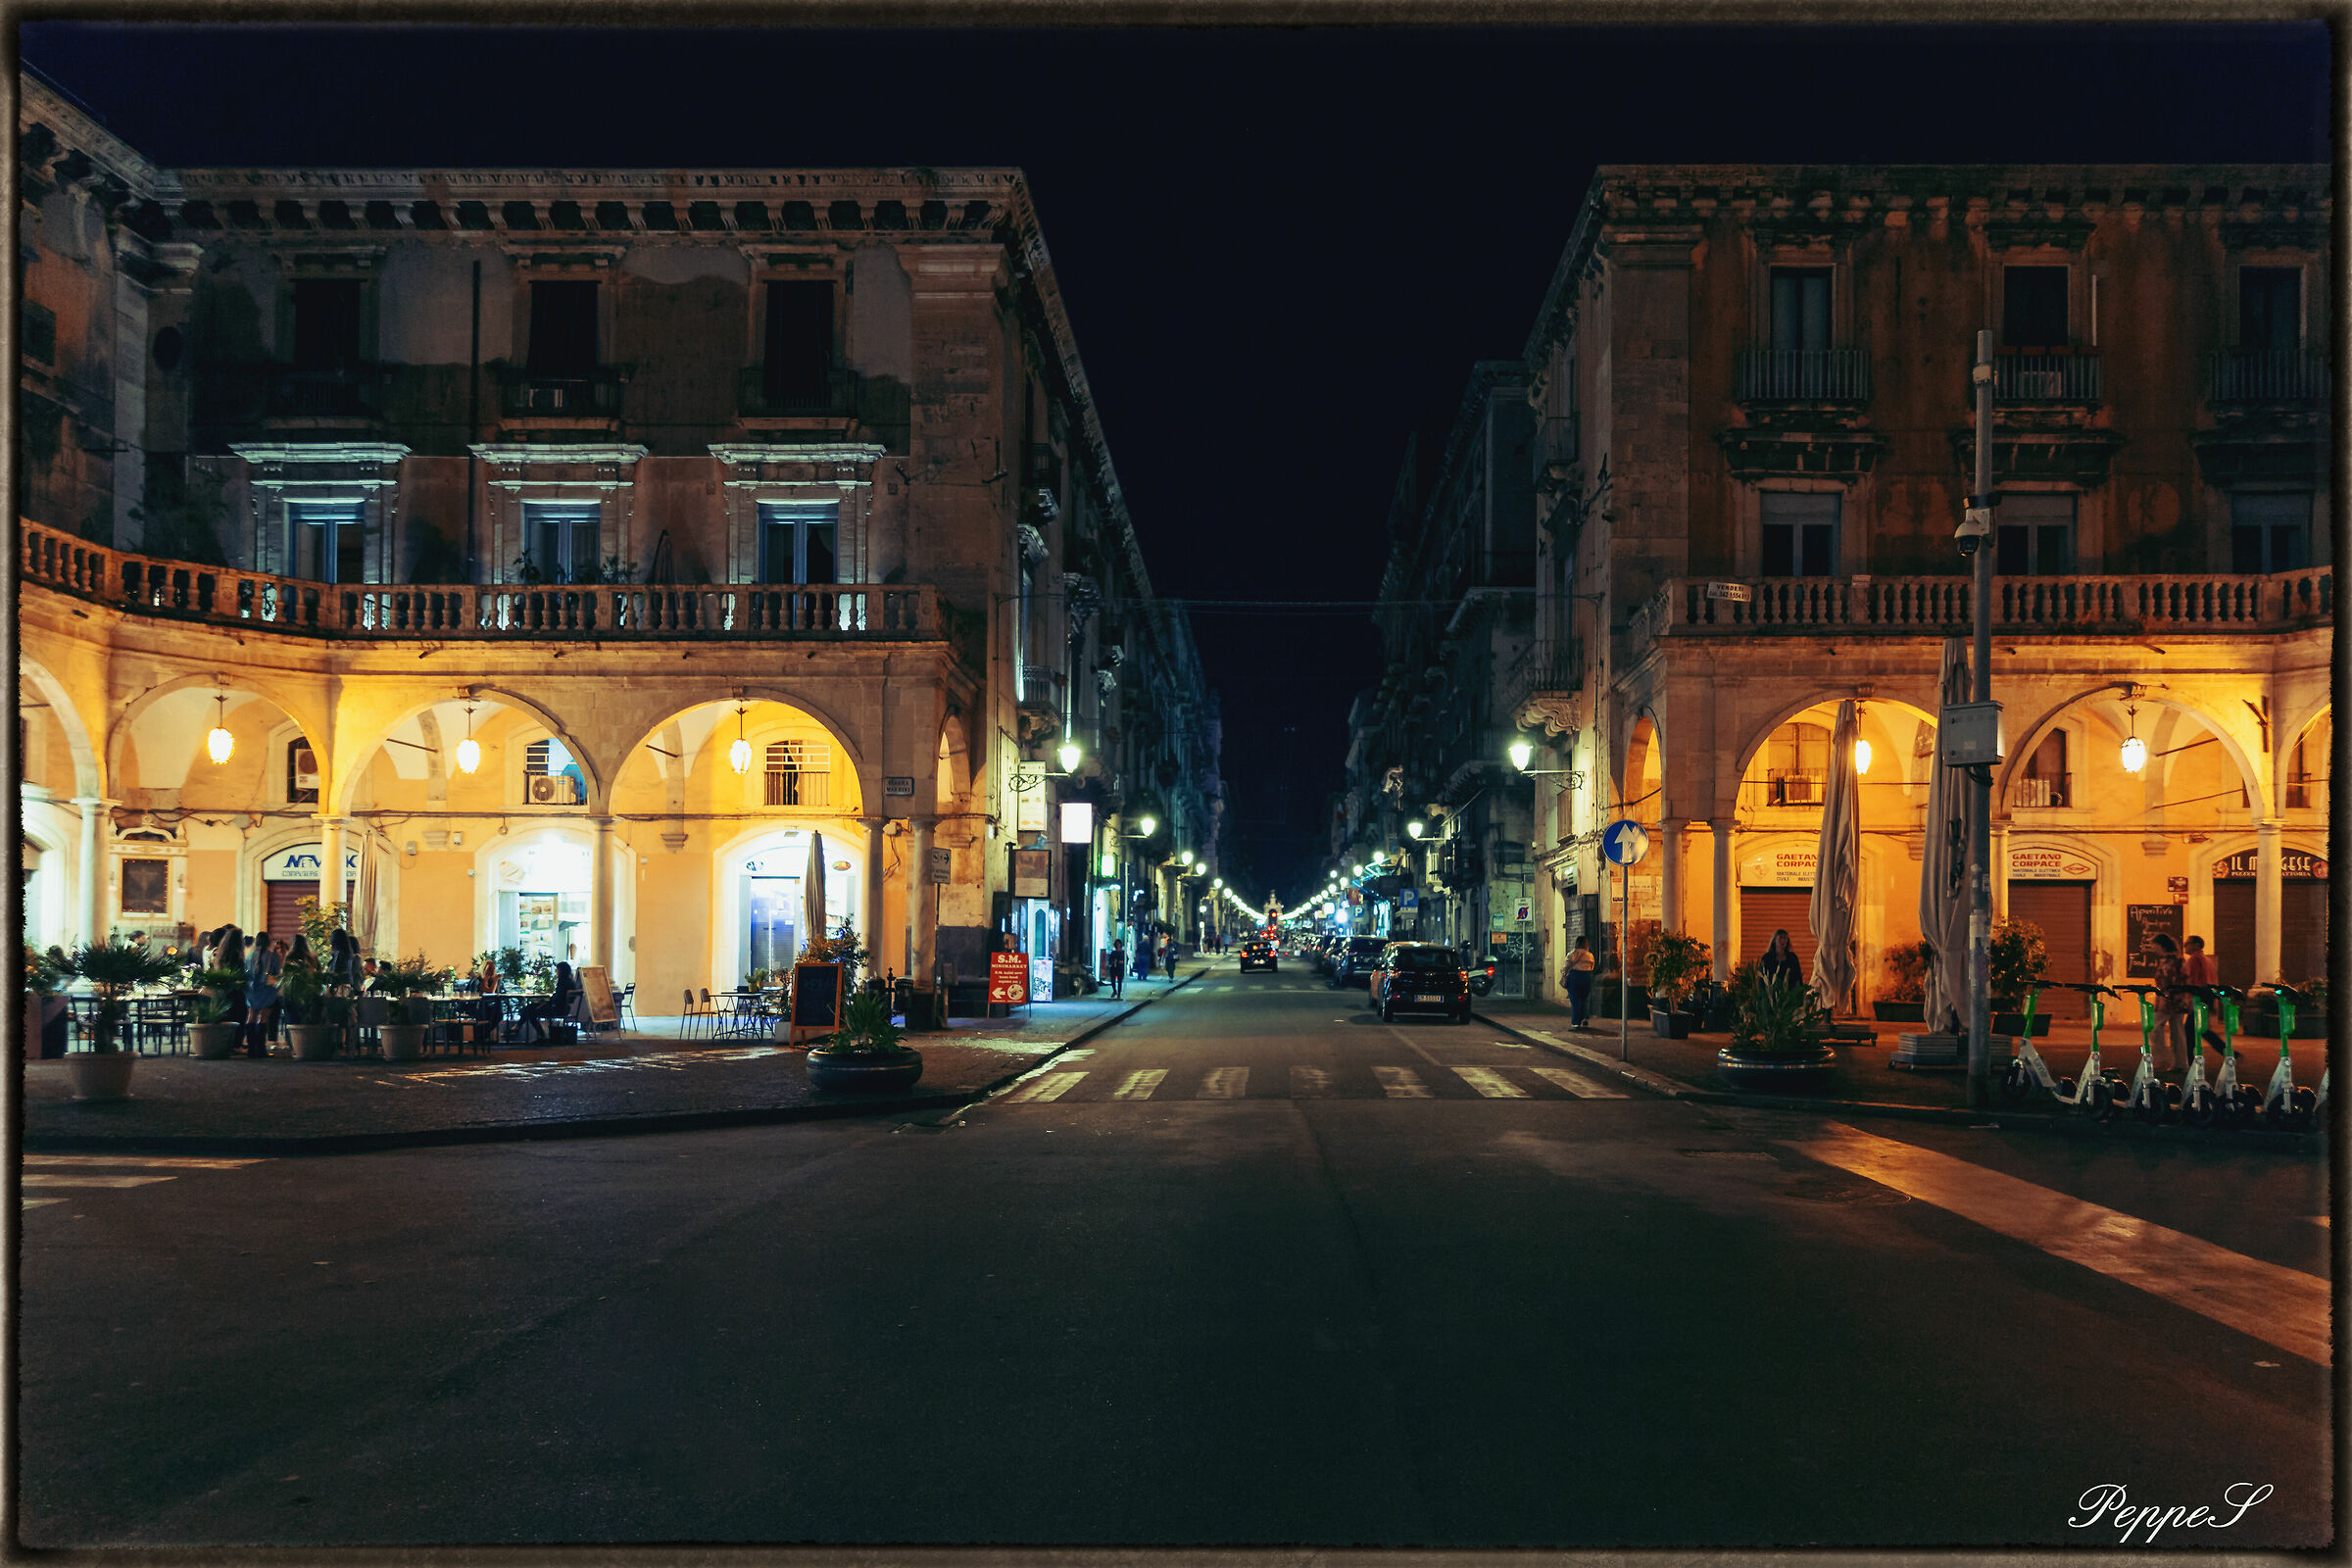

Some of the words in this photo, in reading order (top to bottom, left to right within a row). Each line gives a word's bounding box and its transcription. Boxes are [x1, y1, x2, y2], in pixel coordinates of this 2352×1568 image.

[283, 855, 359, 868] NETK
[2230, 856, 2243, 871] IL
[1403, 891, 1414, 906] P
[1354, 906, 1363, 917] P
[998, 955, 1022, 963] S.M.
